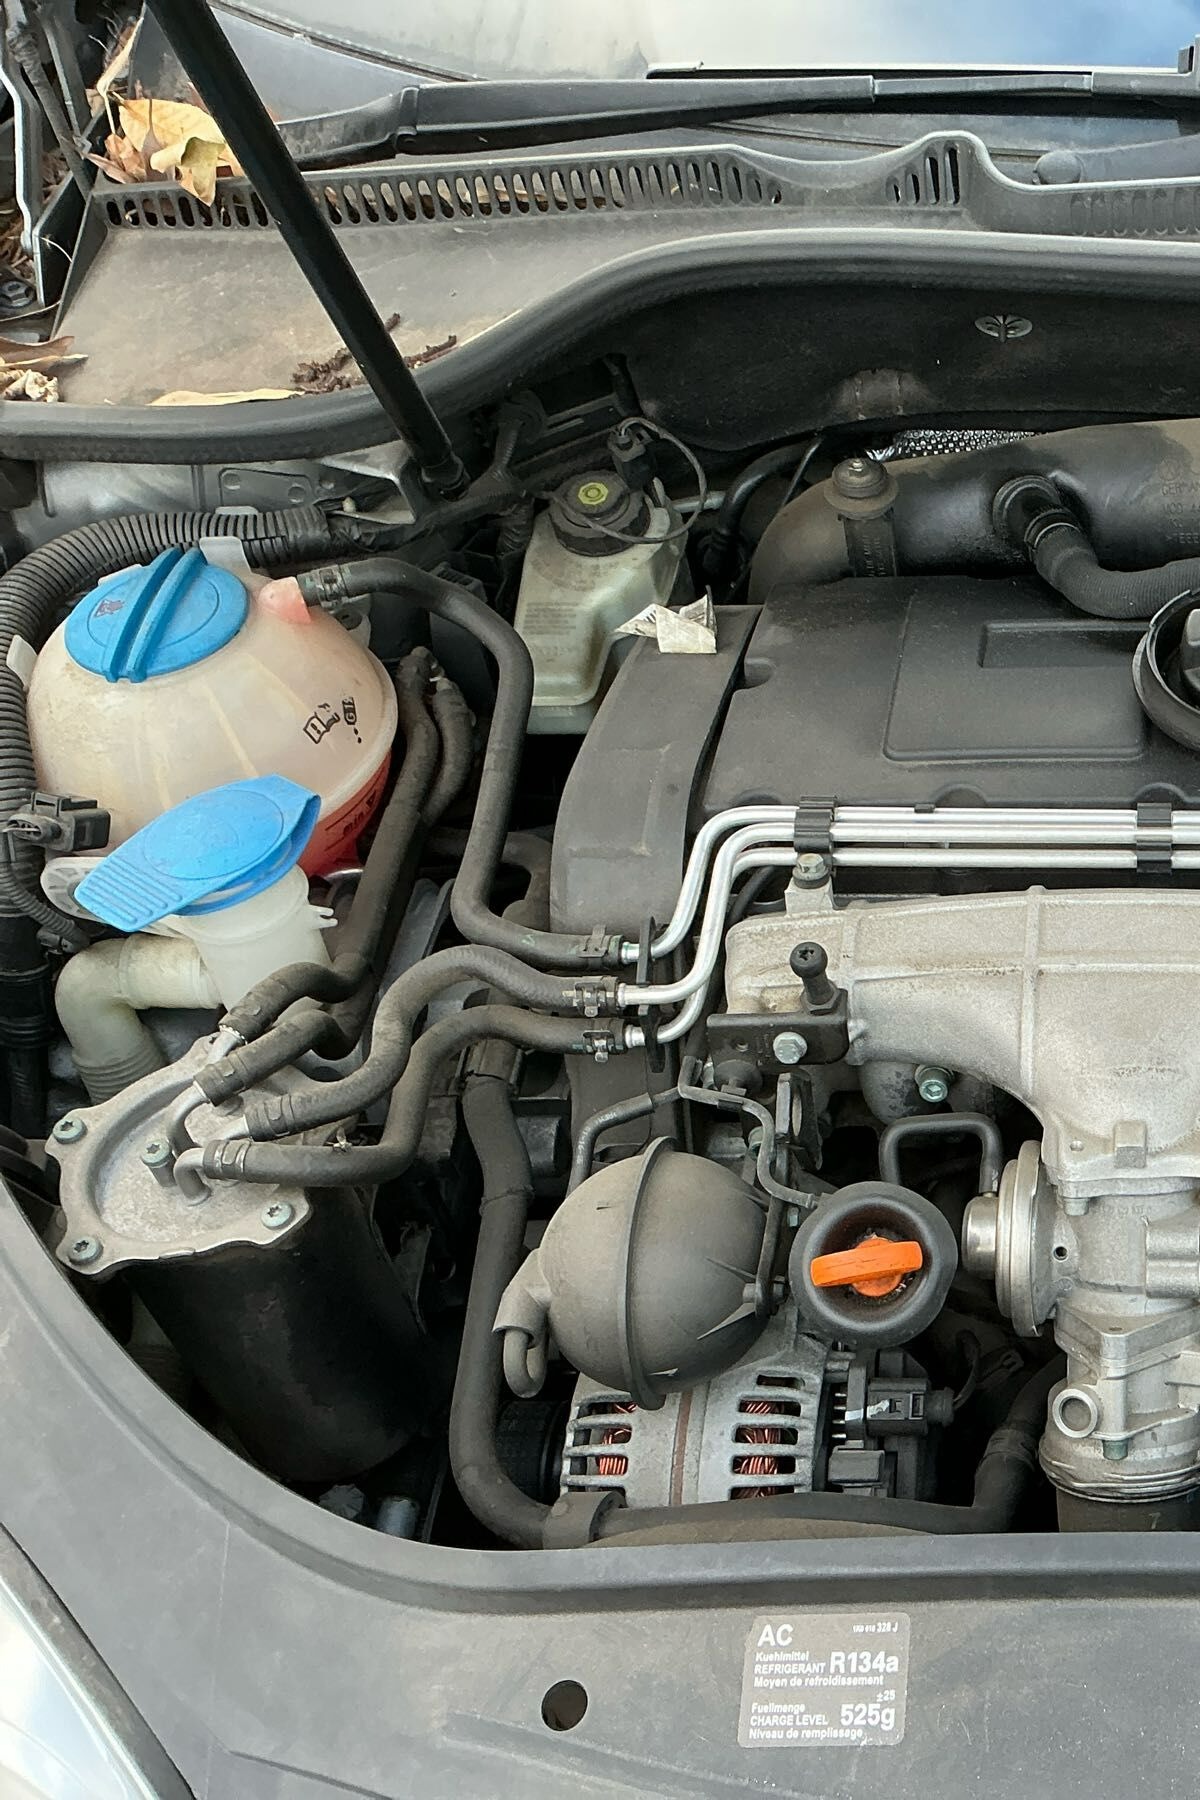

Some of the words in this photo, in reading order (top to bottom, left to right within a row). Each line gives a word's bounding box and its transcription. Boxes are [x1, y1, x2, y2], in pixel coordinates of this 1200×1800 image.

[757, 1623, 794, 1647] AC
[892, 1621, 899, 1632] J
[754, 1663, 826, 1674] REFRIGERANT
[755, 1651, 809, 1662] Kuehlmittel
[830, 1651, 899, 1674] R134a
[754, 1676, 787, 1688] Moyen
[789, 1676, 802, 1687] de
[804, 1675, 884, 1686] refroidissement
[750, 1715, 793, 1727] CHARGE
[795, 1715, 829, 1726] LEVEL
[751, 1702, 806, 1714] Fuellmenge
[840, 1704, 896, 1731] 525g
[749, 1728, 784, 1739] Niveau
[786, 1728, 798, 1738] de
[801, 1728, 863, 1740] remplissage
